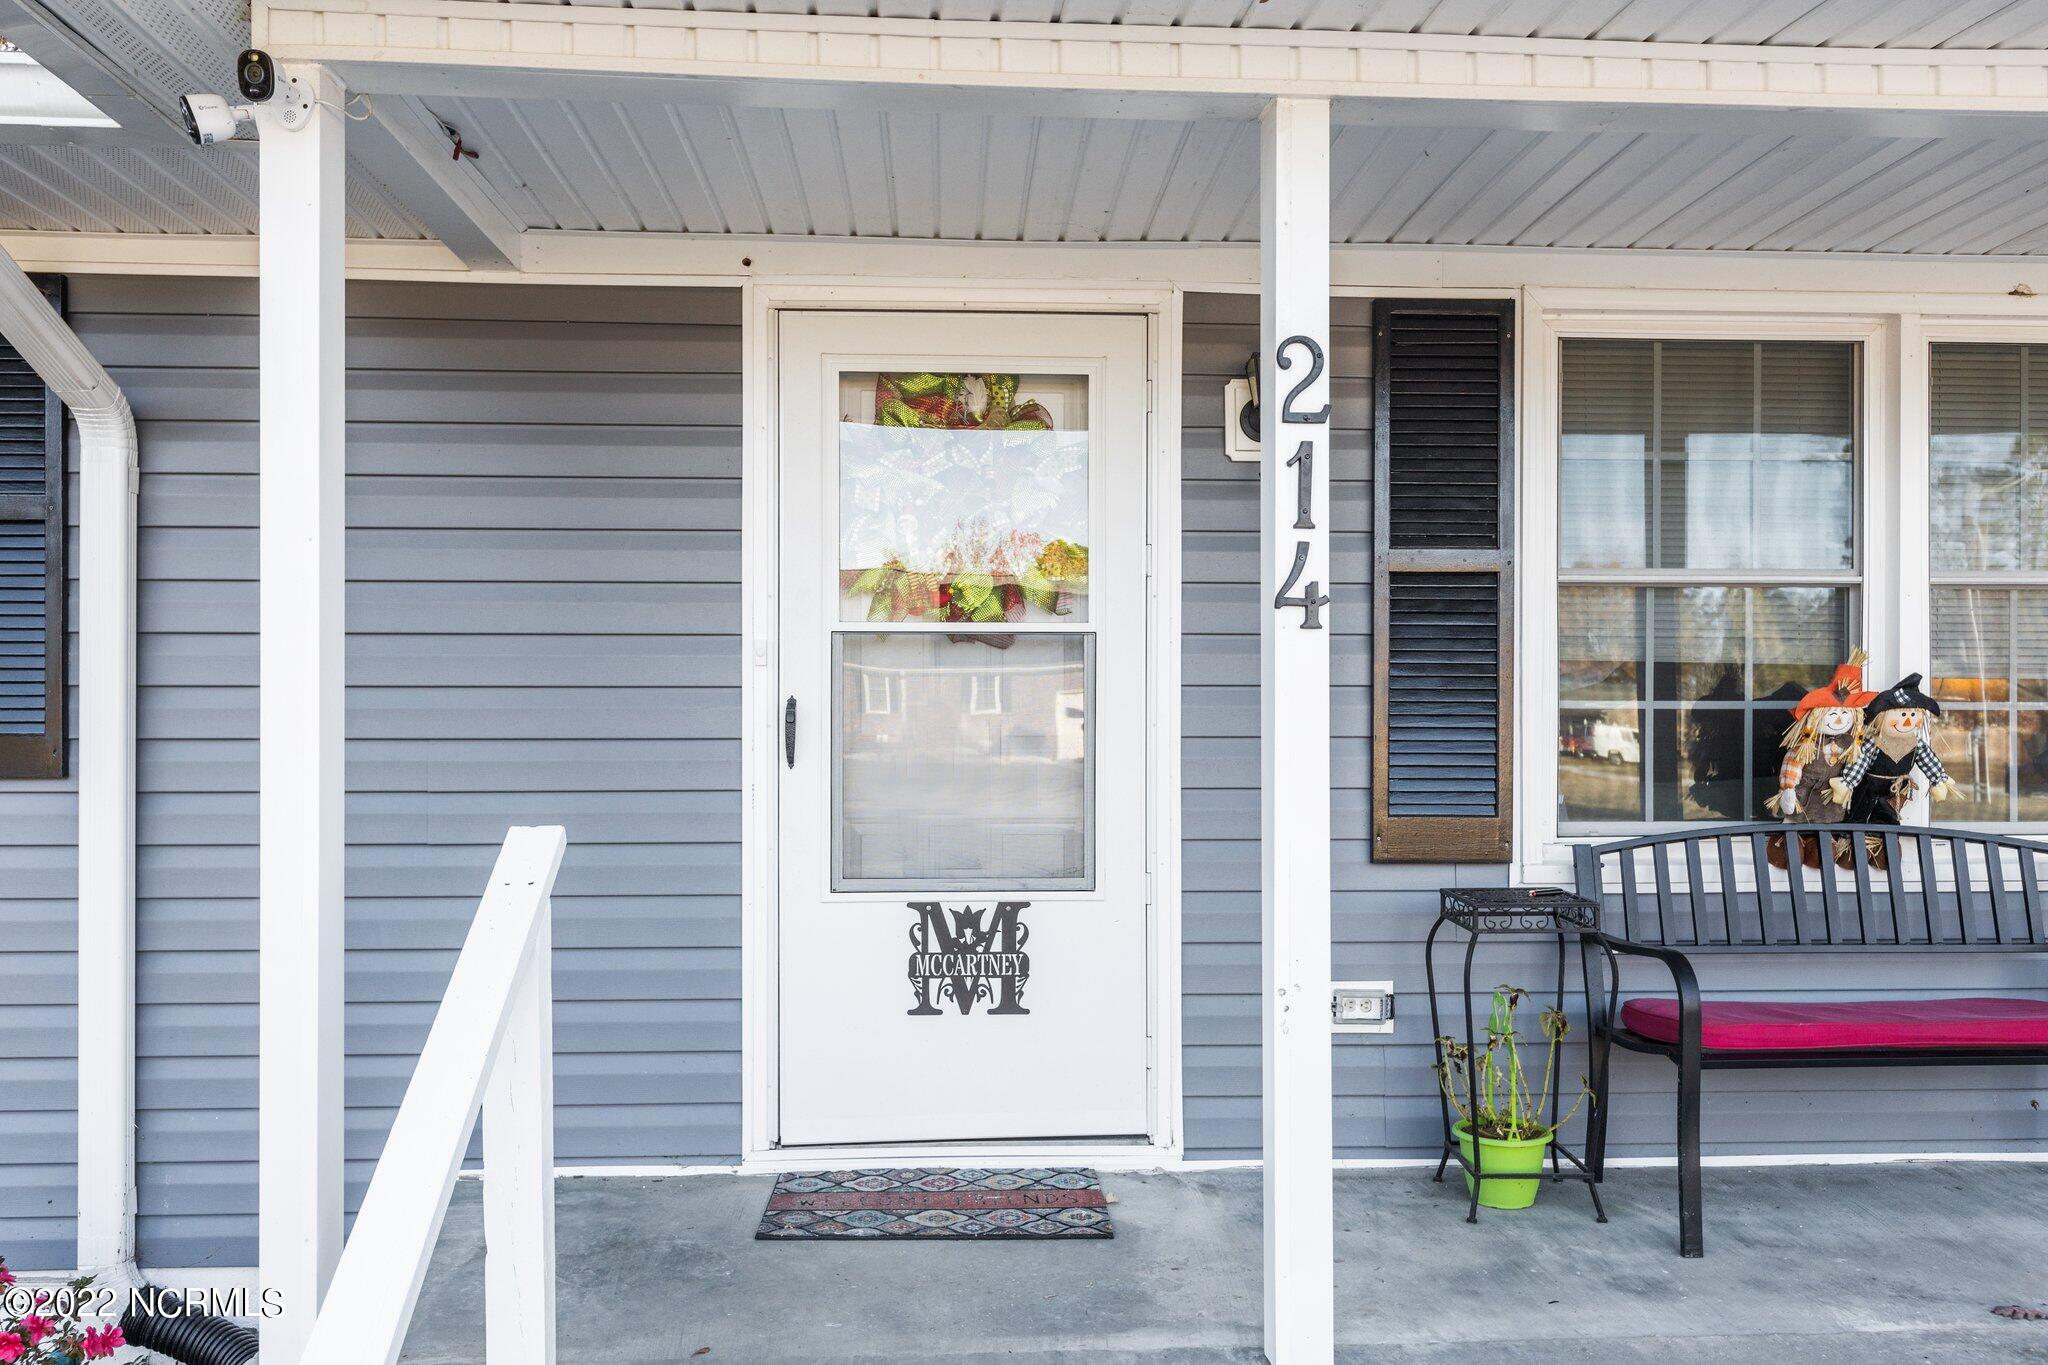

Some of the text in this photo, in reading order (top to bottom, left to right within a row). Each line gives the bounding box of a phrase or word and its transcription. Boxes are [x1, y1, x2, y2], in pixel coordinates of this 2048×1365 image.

[1274, 335, 1332, 629] 214
[915, 953, 1024, 976] MCCARTNEY
[800, 1195, 932, 1207] WLCOM
